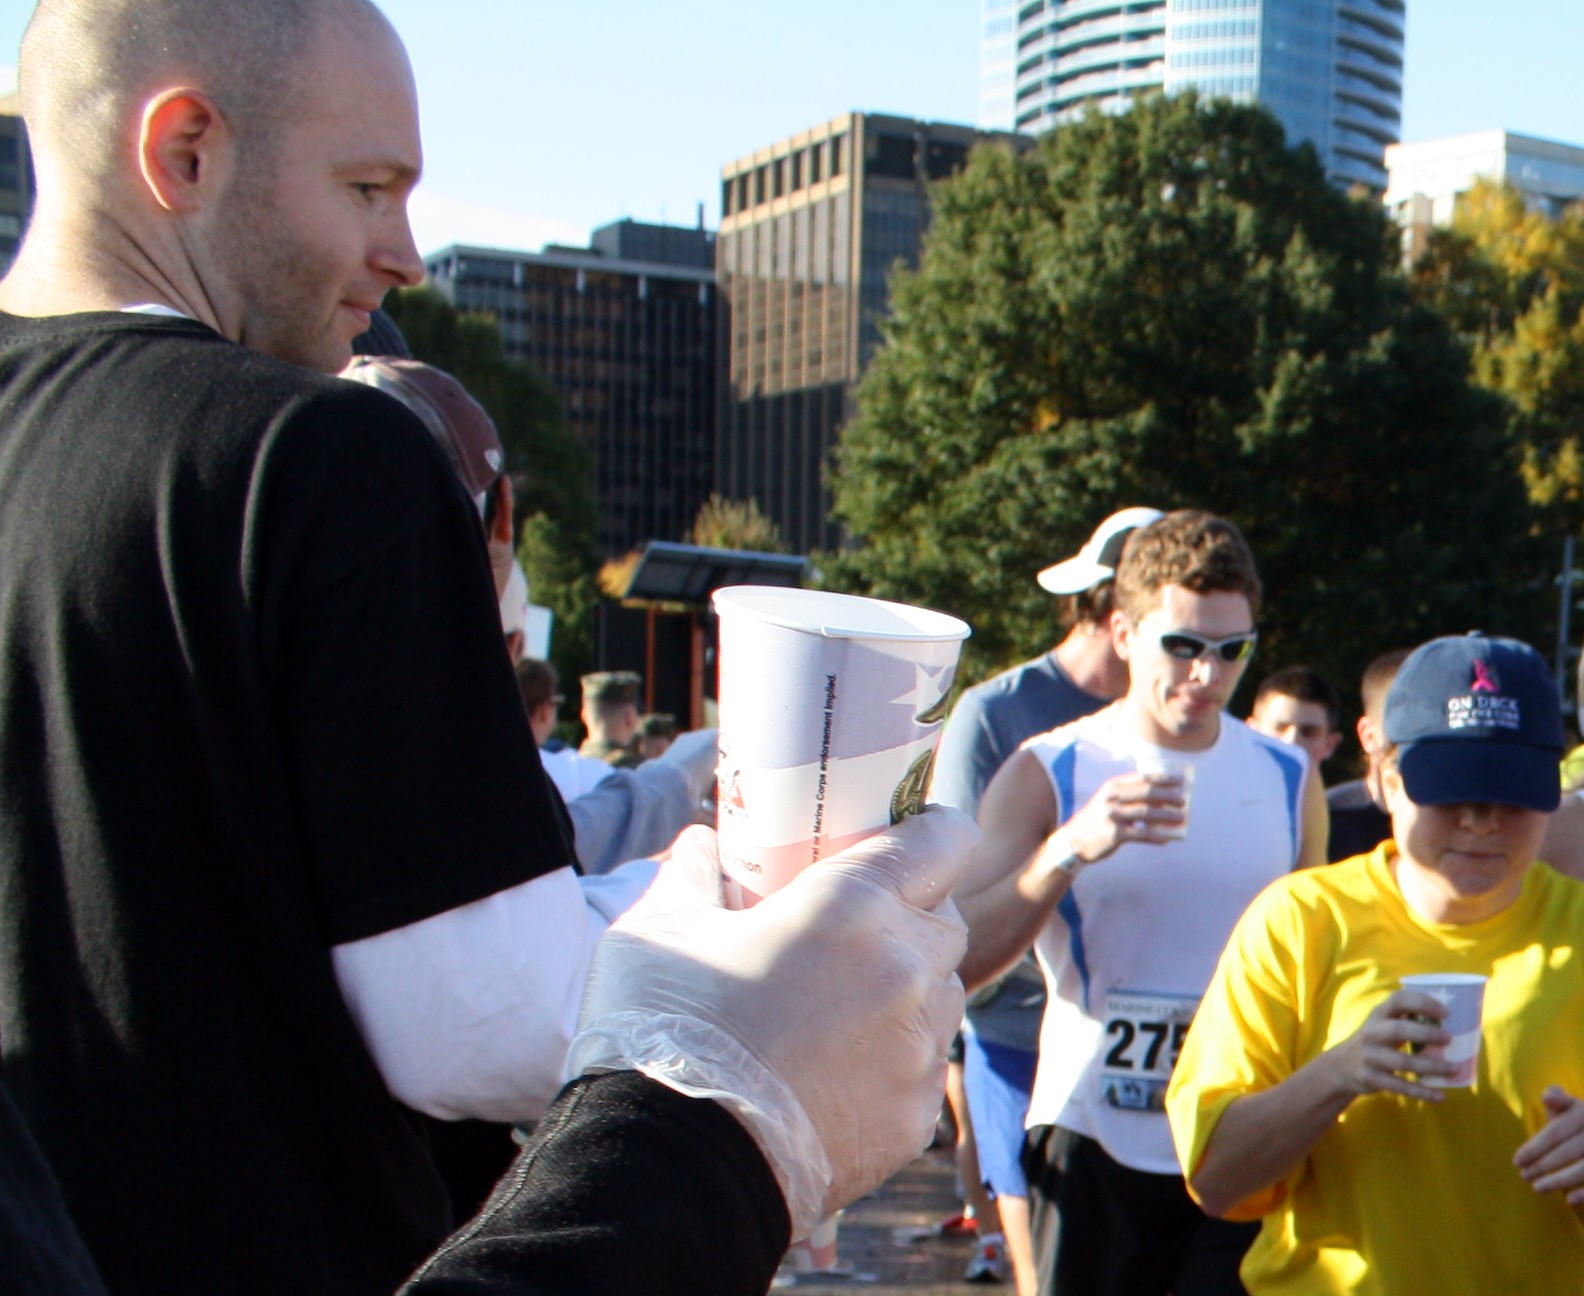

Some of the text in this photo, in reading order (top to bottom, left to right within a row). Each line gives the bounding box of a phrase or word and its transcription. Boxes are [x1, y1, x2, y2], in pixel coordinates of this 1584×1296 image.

[1447, 695, 1473, 711] ON
[819, 712, 835, 772] endorsement
[816, 774, 829, 801] Corps
[814, 803, 824, 834] Marine
